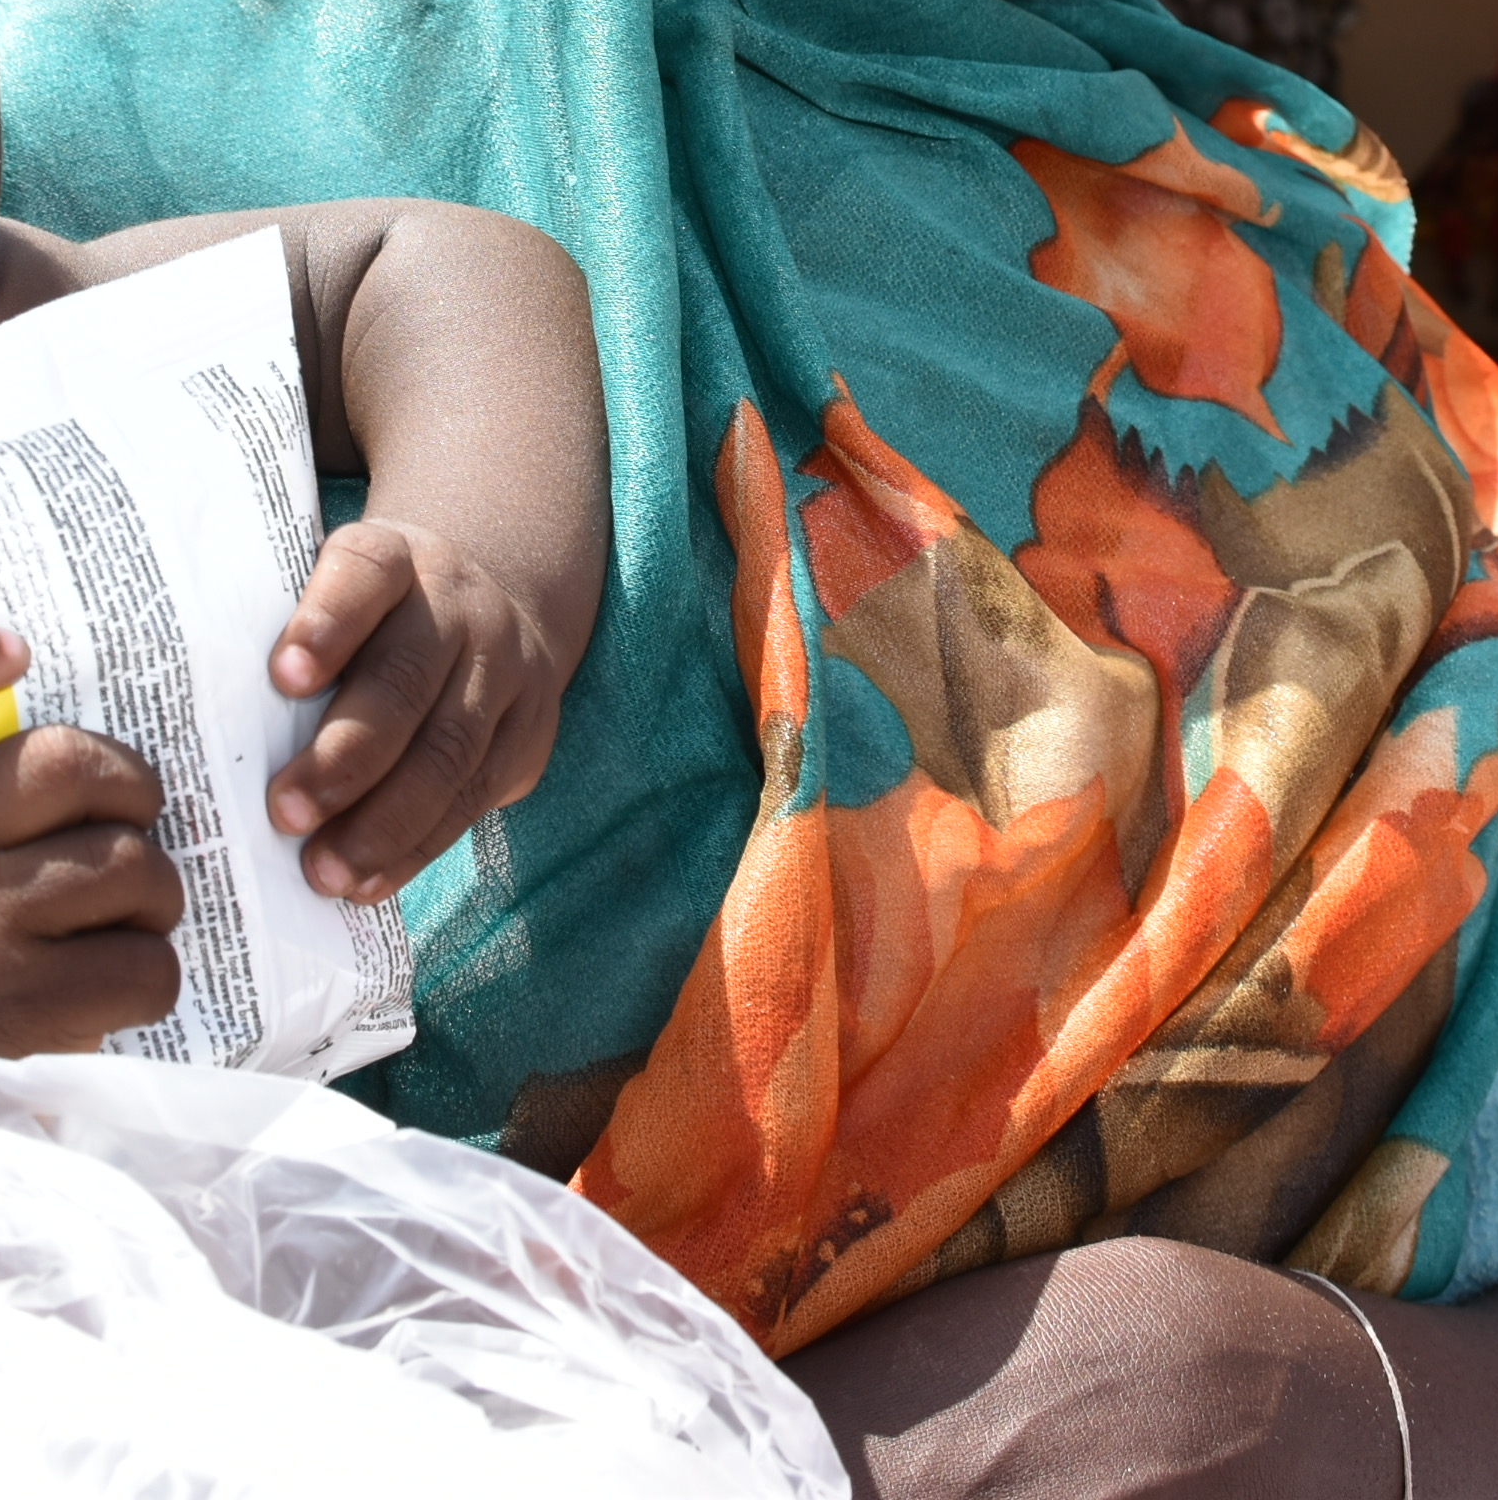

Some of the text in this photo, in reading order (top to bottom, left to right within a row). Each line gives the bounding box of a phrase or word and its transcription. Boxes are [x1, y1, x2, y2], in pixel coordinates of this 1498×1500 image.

[207, 367, 220, 380] See
[219, 381, 245, 414] technical
[246, 417, 258, 435] data
[257, 438, 270, 462] sheet
[269, 471, 289, 527] Conditionné
[286, 530, 296, 552] sous
[217, 363, 247, 397] Packaged
[255, 417, 277, 461] protective
[293, 523, 311, 577] Nutritional
[85, 484, 106, 522] contain
[233, 413, 253, 445] Valeurs
[252, 447, 277, 518] nutritionnelles
[277, 526, 285, 543] voir
[283, 546, 292, 570] fiche
[54, 507, 83, 555] végétales
[89, 526, 119, 587] proportions
[104, 526, 121, 560] traces
[46, 499, 64, 529] relatif
[66, 555, 89, 611] allergènes
[87, 621, 100, 643] peut
[65, 493, 91, 544] arachides,
[90, 550, 104, 580] farine
[107, 600, 119, 622] soja
[124, 677, 139, 728] complexe
[108, 467, 136, 511] vegetable
[134, 515, 145, 533] oils
[162, 594, 176, 621] palm,
[178, 659, 193, 700] varying
[201, 773, 215, 803] sugar,
[211, 808, 222, 837] whey
[111, 488, 124, 509] milk
[120, 512, 139, 547] powder,
[135, 553, 157, 596] peanuts,
[154, 600, 175, 644] defatted
[174, 664, 185, 688] flour,
[187, 754, 202, 792] mineral
[133, 650, 143, 680] sucre,
[146, 647, 155, 668] free
[119, 533, 141, 582] vegetable
[138, 586, 149, 606] oils,
[163, 669, 173, 698] mono
[184, 794, 200, 845] Allergens
[136, 684, 151, 723] poudre
[150, 682, 171, 749] Ingrédients
[164, 758, 177, 792] huiles
[159, 813, 175, 850] poudre
[170, 796, 187, 848] végétales
[219, 846, 235, 897] Consume
[182, 856, 202, 925] l'alimentation
[199, 942, 218, 1005] complément
[195, 854, 207, 880] dans
[201, 882, 210, 898] les
[208, 925, 224, 964] suivant
[218, 967, 236, 1030] l'ouverture.
[210, 866, 233, 950] complementary
[228, 955, 241, 980] food
[230, 900, 242, 933] within
[236, 936, 247, 949] 24
[240, 951, 253, 983] hours
[172, 1018, 186, 1046] birth,
